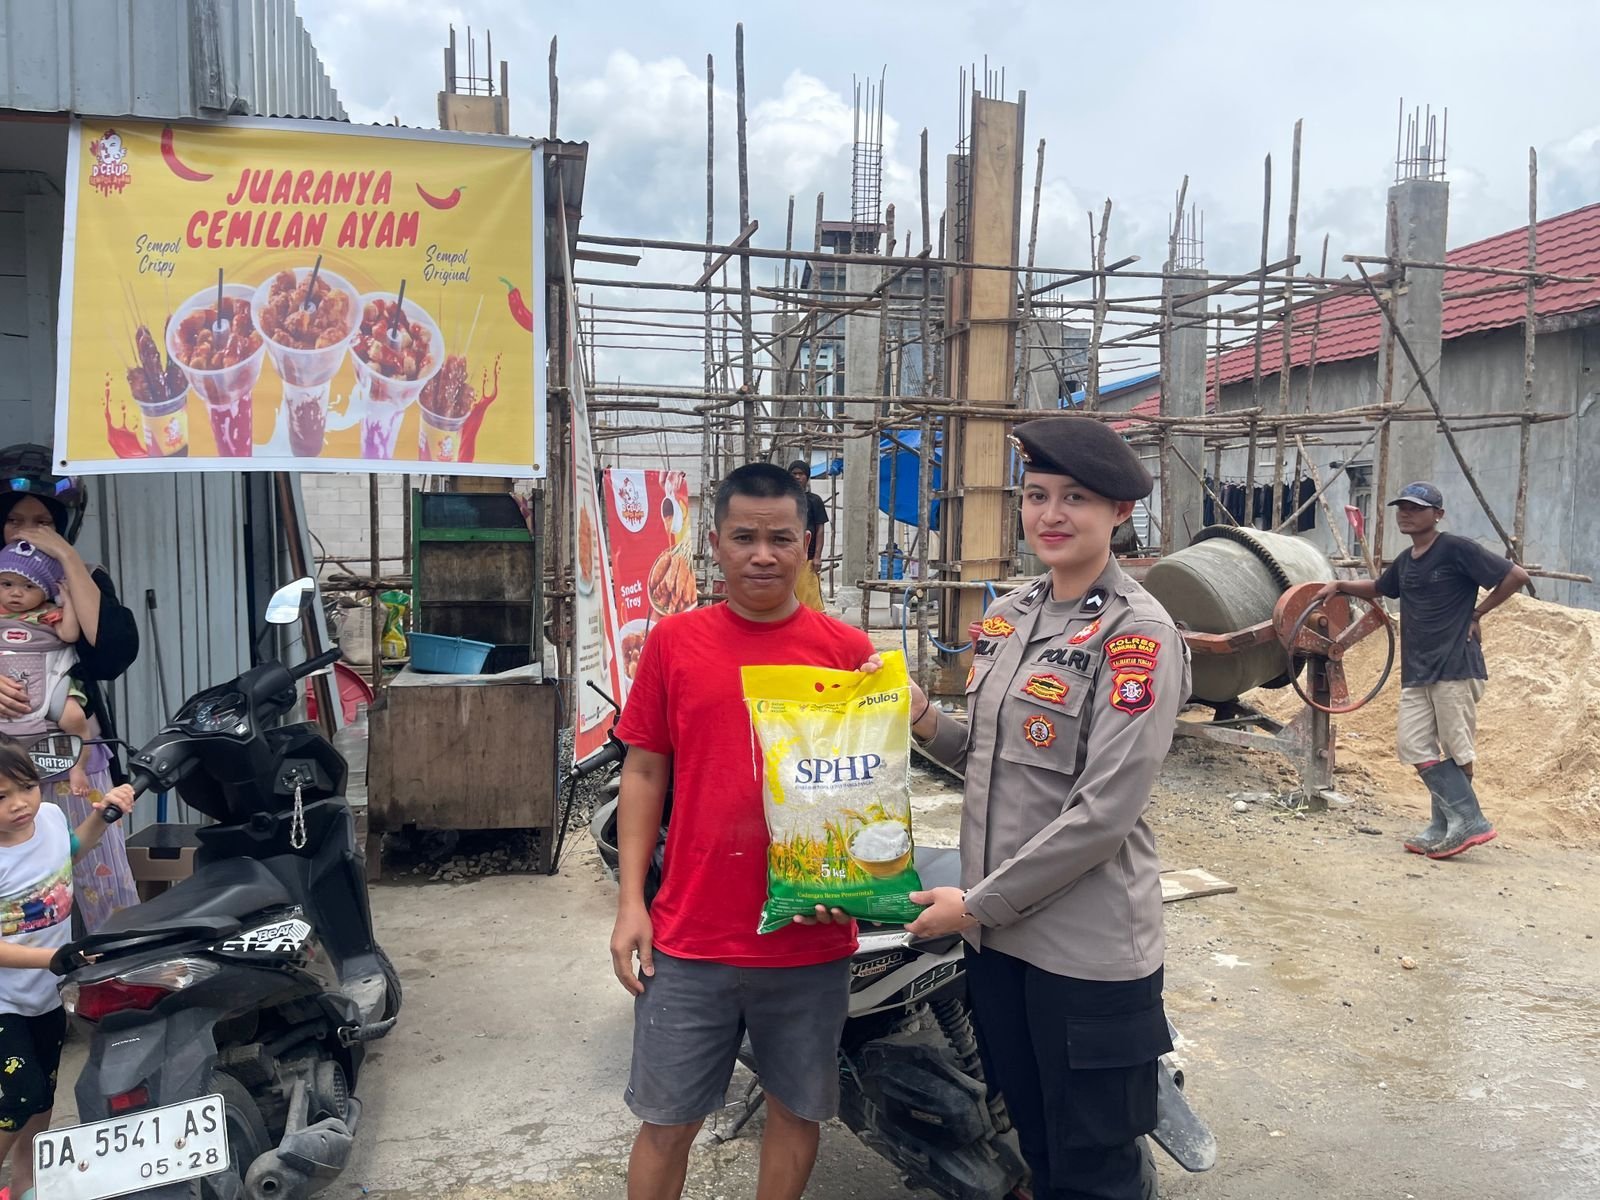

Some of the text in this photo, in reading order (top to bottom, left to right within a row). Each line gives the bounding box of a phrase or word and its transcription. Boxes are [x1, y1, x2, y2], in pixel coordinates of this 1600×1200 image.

[227, 168, 392, 206] JUARANYA
[186, 210, 419, 249] CEMILAN AYAM
[136, 234, 181, 256] Sempol
[426, 244, 468, 267] Sempol
[139, 254, 175, 278] Crispy
[424, 263, 470, 286] Original
[620, 580, 642, 597] Snack
[625, 595, 641, 609] Tray
[1109, 638, 1156, 650] POLRES
[1038, 648, 1091, 672] POLRI
[866, 693, 899, 706] bulog
[795, 753, 881, 784] SPHP
[821, 863, 846, 879] 5 kg
[38, 1105, 218, 1170] DA 5541 AS
